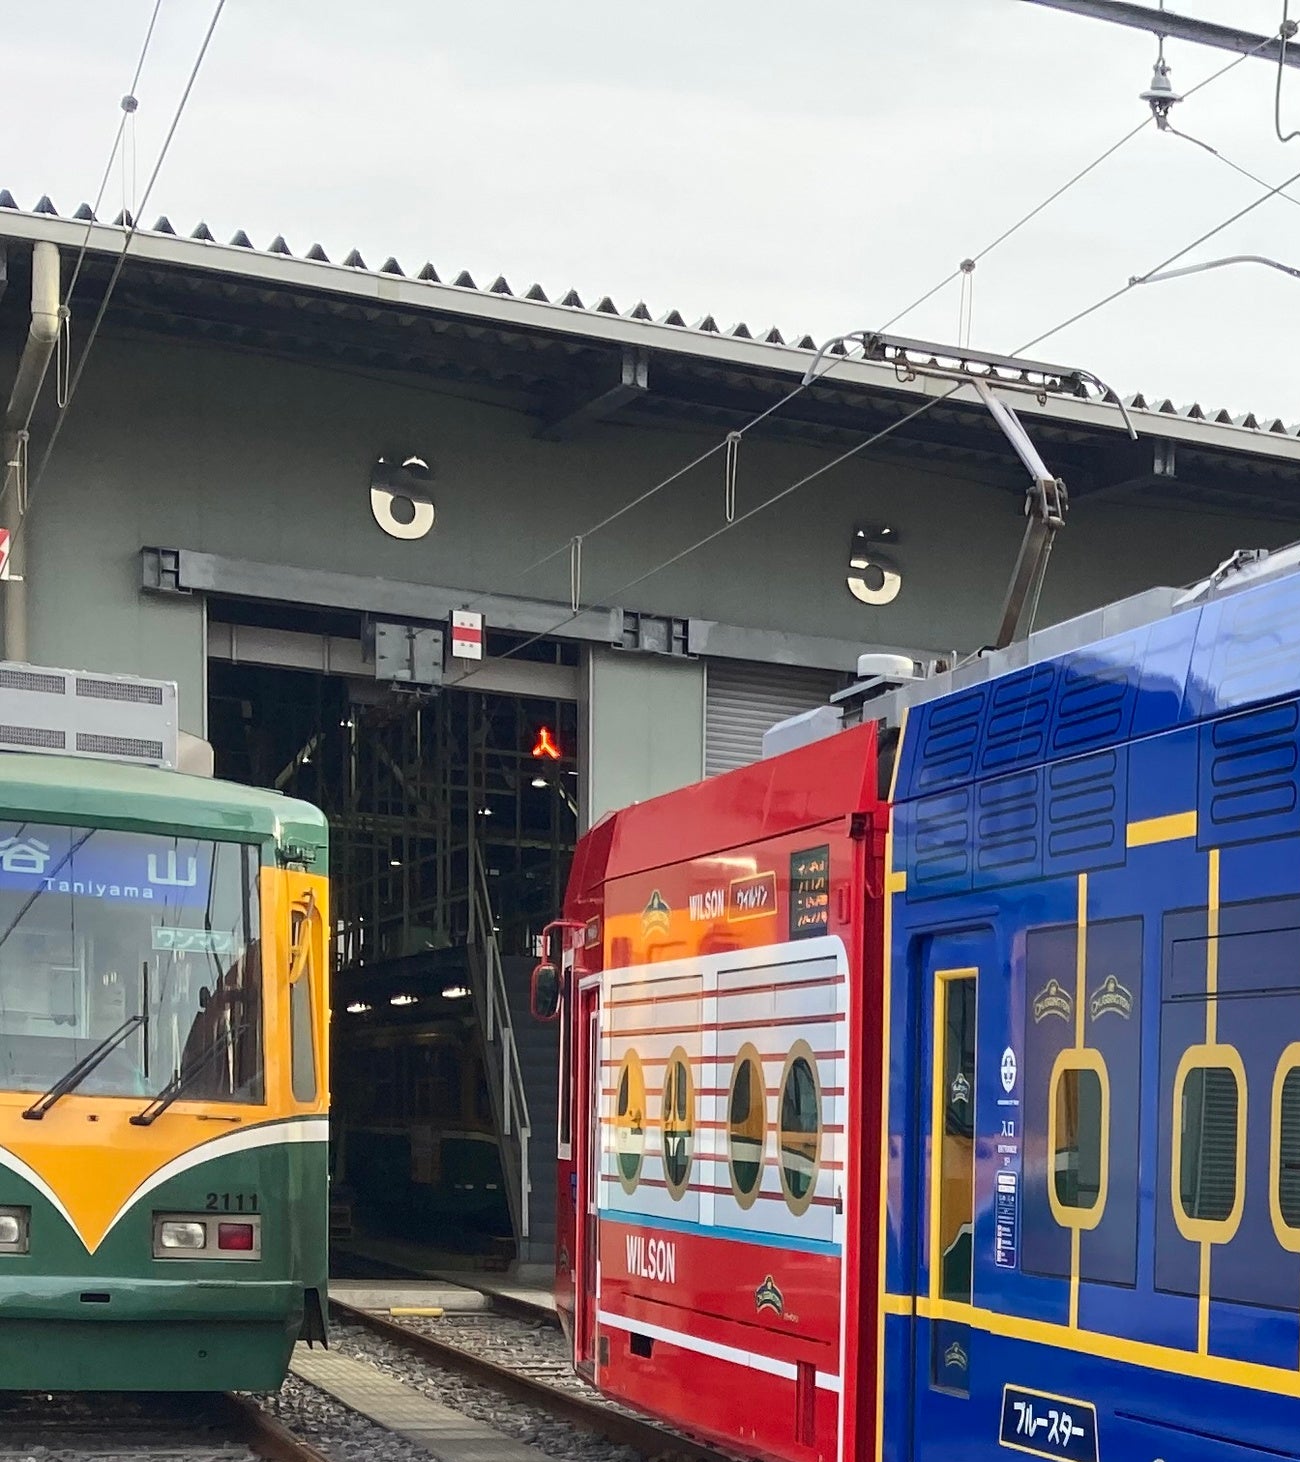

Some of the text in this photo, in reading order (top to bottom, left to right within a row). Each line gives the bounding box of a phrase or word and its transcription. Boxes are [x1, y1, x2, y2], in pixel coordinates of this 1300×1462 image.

[847, 525, 902, 605] 5
[43, 876, 153, 899] Taniyama
[688, 888, 724, 922] WILSON
[157, 930, 232, 948] ワンマン
[1001, 1120, 1015, 1137] 入口
[206, 1192, 257, 1211] 2111
[626, 1234, 676, 1284] WILSON
